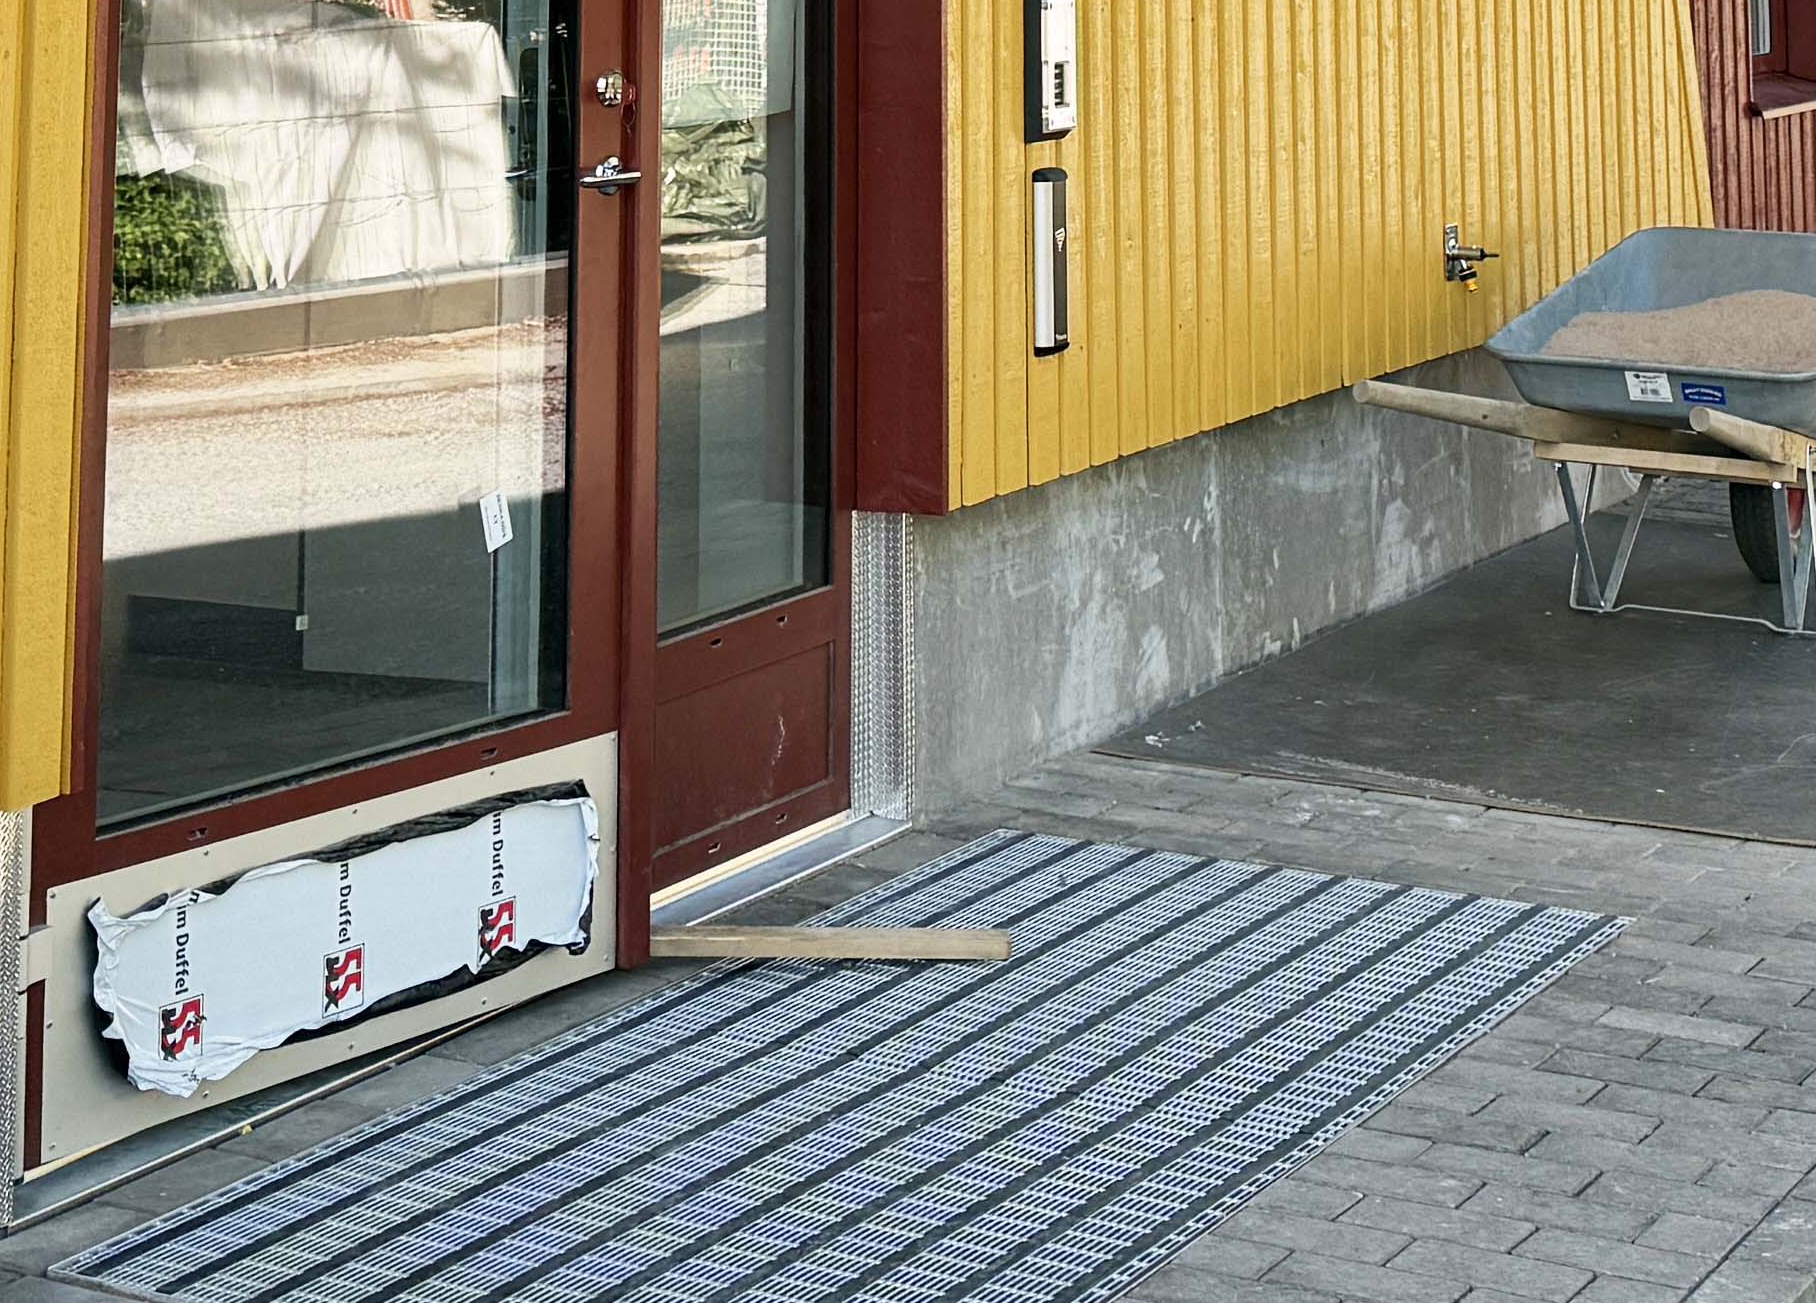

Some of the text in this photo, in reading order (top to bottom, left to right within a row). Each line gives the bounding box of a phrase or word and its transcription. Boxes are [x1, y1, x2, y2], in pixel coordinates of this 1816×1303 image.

[492, 839, 504, 897] Duffel
[338, 884, 352, 944] Duffel
[175, 933, 190, 995] Duffel
